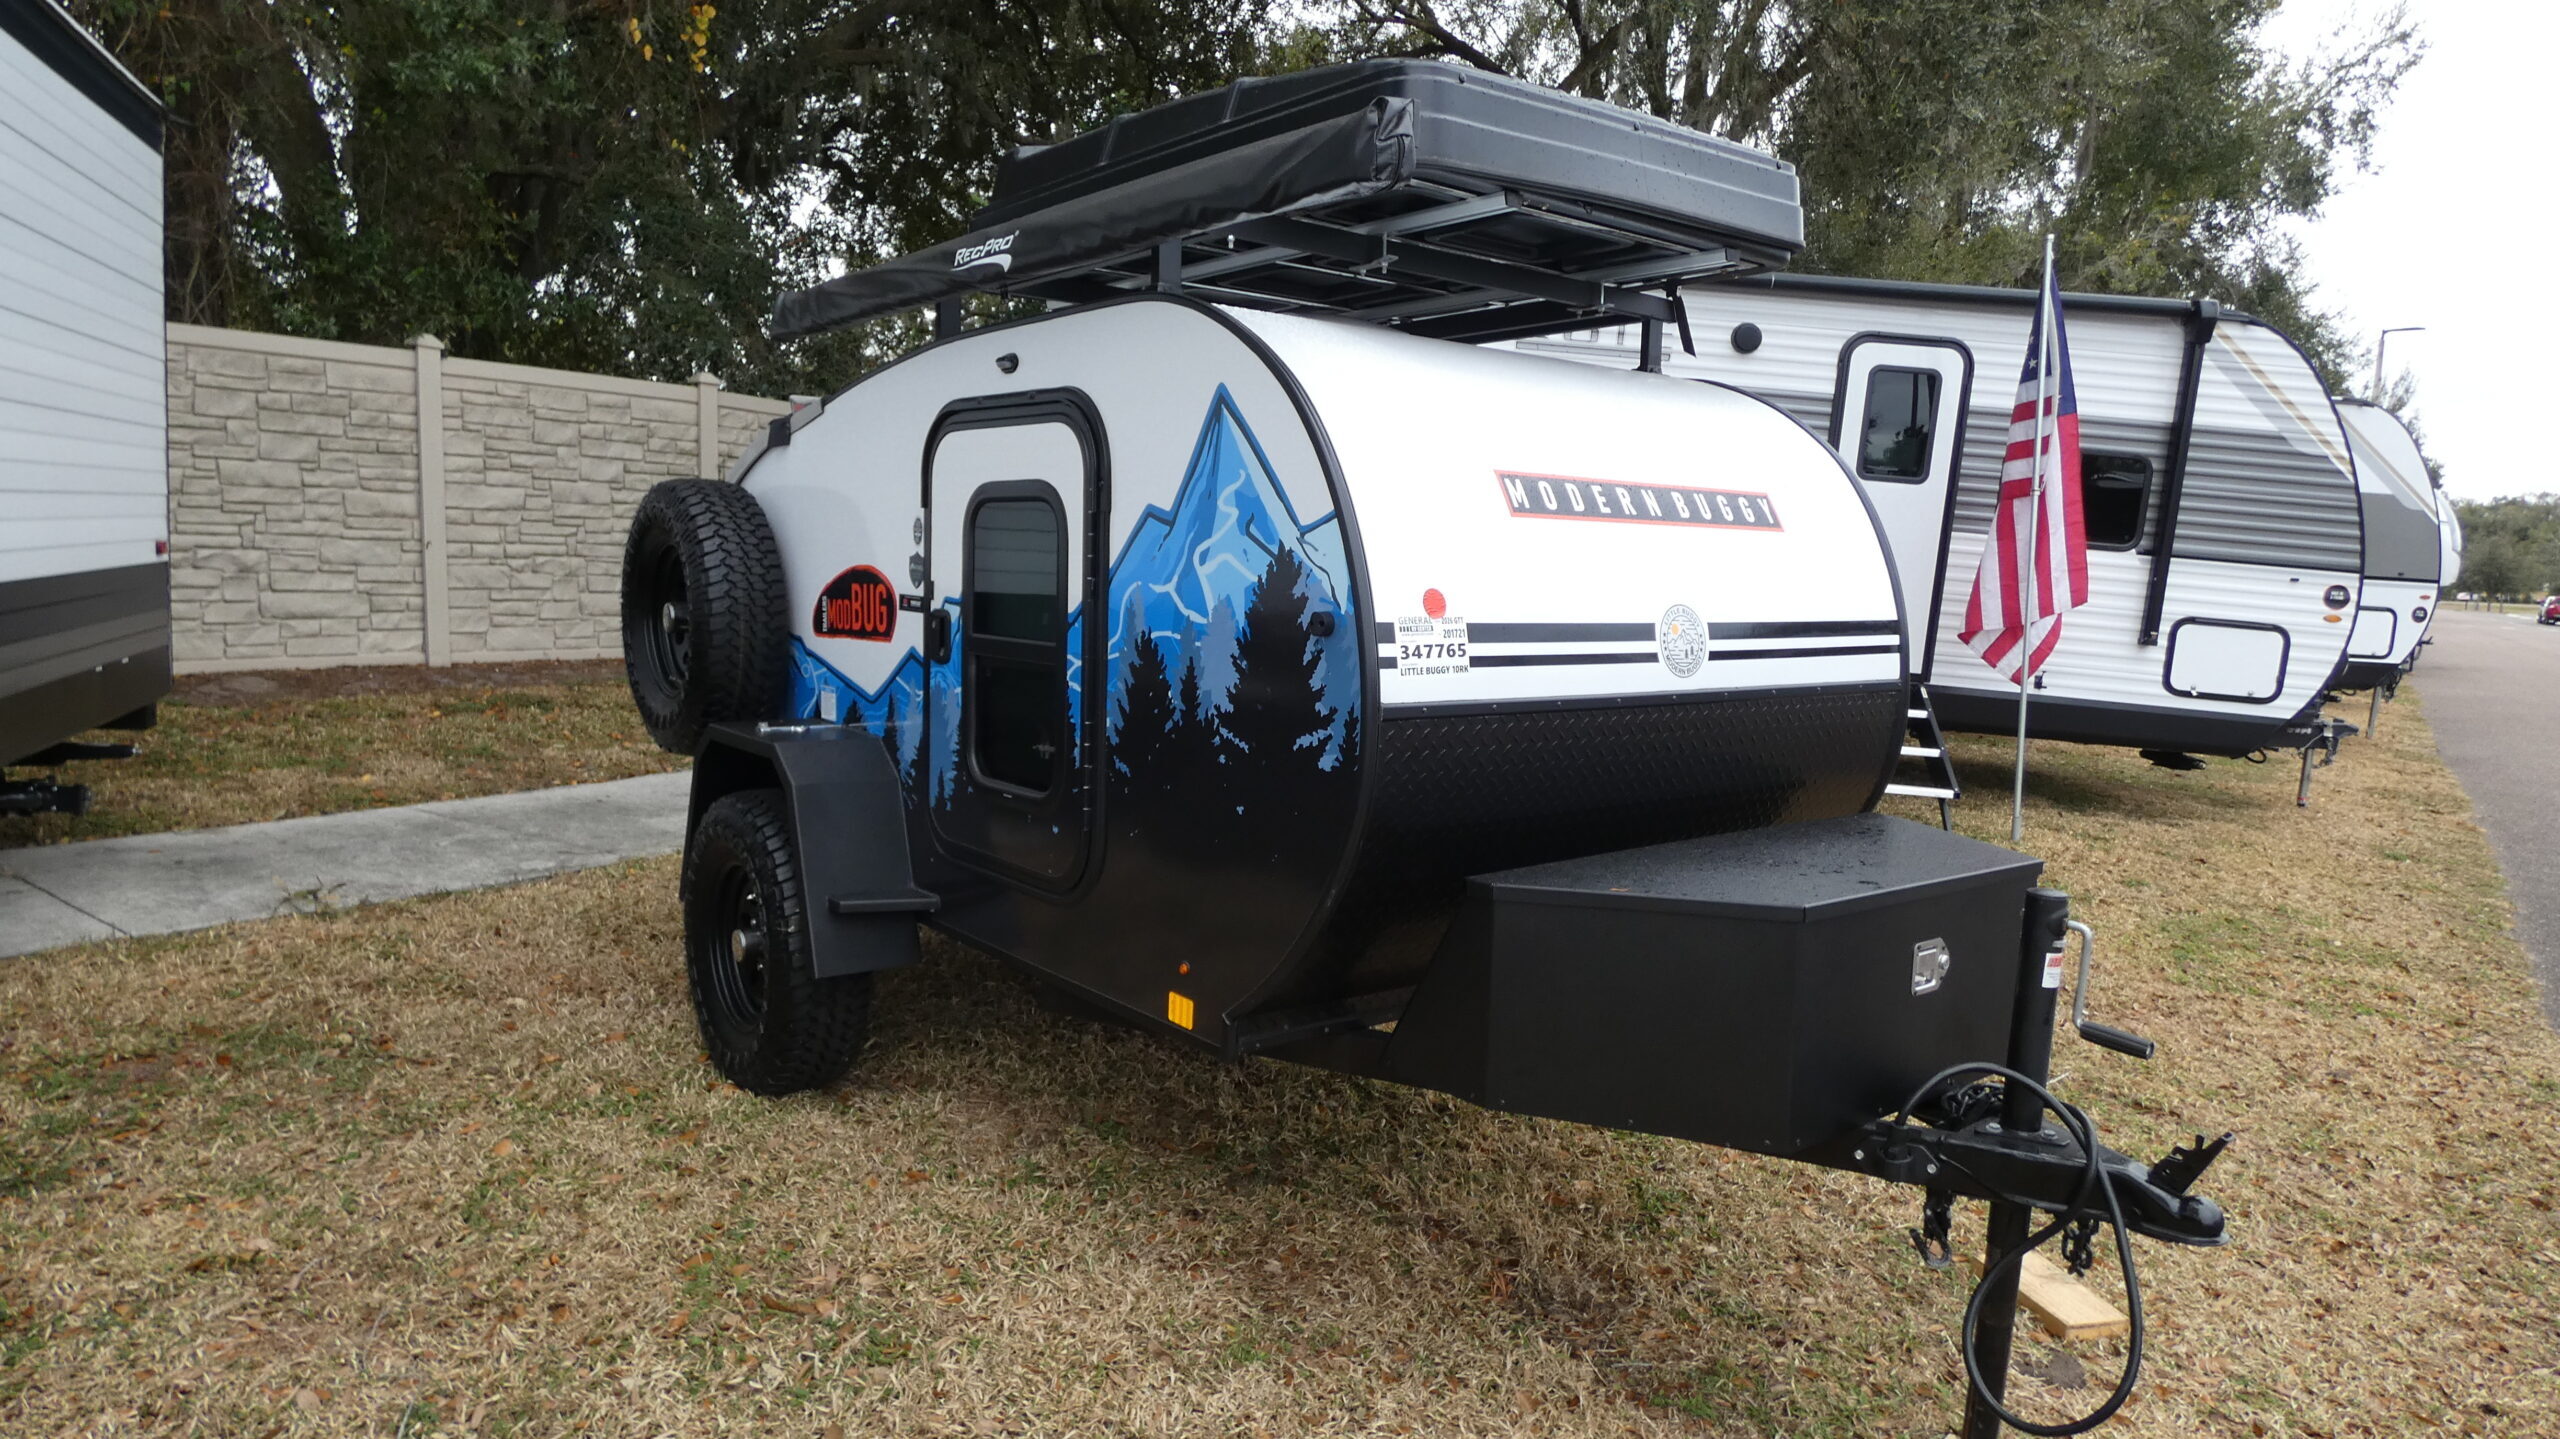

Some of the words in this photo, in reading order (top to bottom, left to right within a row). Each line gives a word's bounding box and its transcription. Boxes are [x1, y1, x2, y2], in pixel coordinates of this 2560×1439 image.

[1504, 478, 1662, 517] MODERN
[1670, 491, 1774, 525] BUGGY
[1398, 616, 1433, 625] GENERAL
[1443, 628, 1466, 639] 201721
[1400, 642, 1467, 660] 347765
[1400, 666, 1424, 677] LITTLE
[1425, 665, 1450, 675] BUGGY
